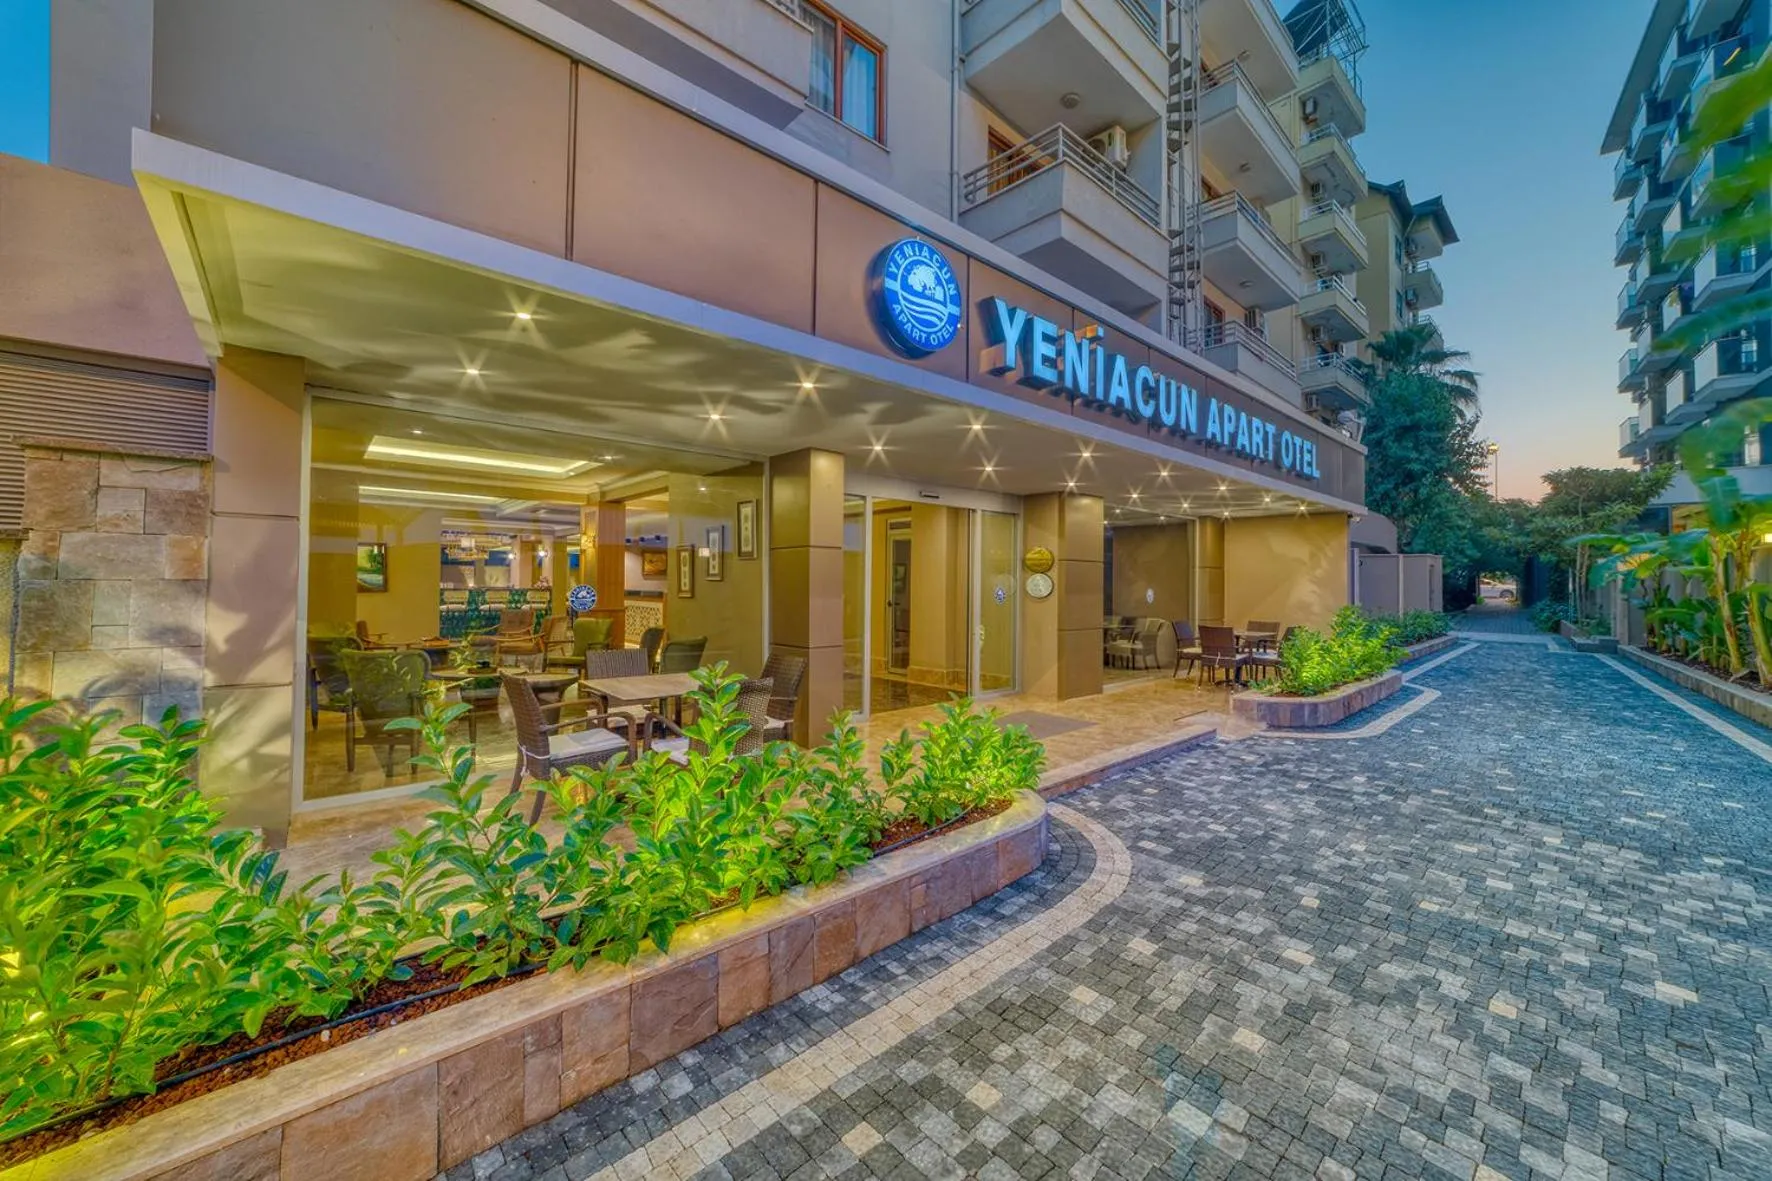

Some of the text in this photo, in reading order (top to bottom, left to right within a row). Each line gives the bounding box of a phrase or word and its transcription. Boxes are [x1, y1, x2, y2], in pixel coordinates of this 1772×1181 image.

[892, 303, 954, 345] APART OTEL
[1206, 398, 1276, 461] APART
[1281, 430, 1321, 478] OTEL
